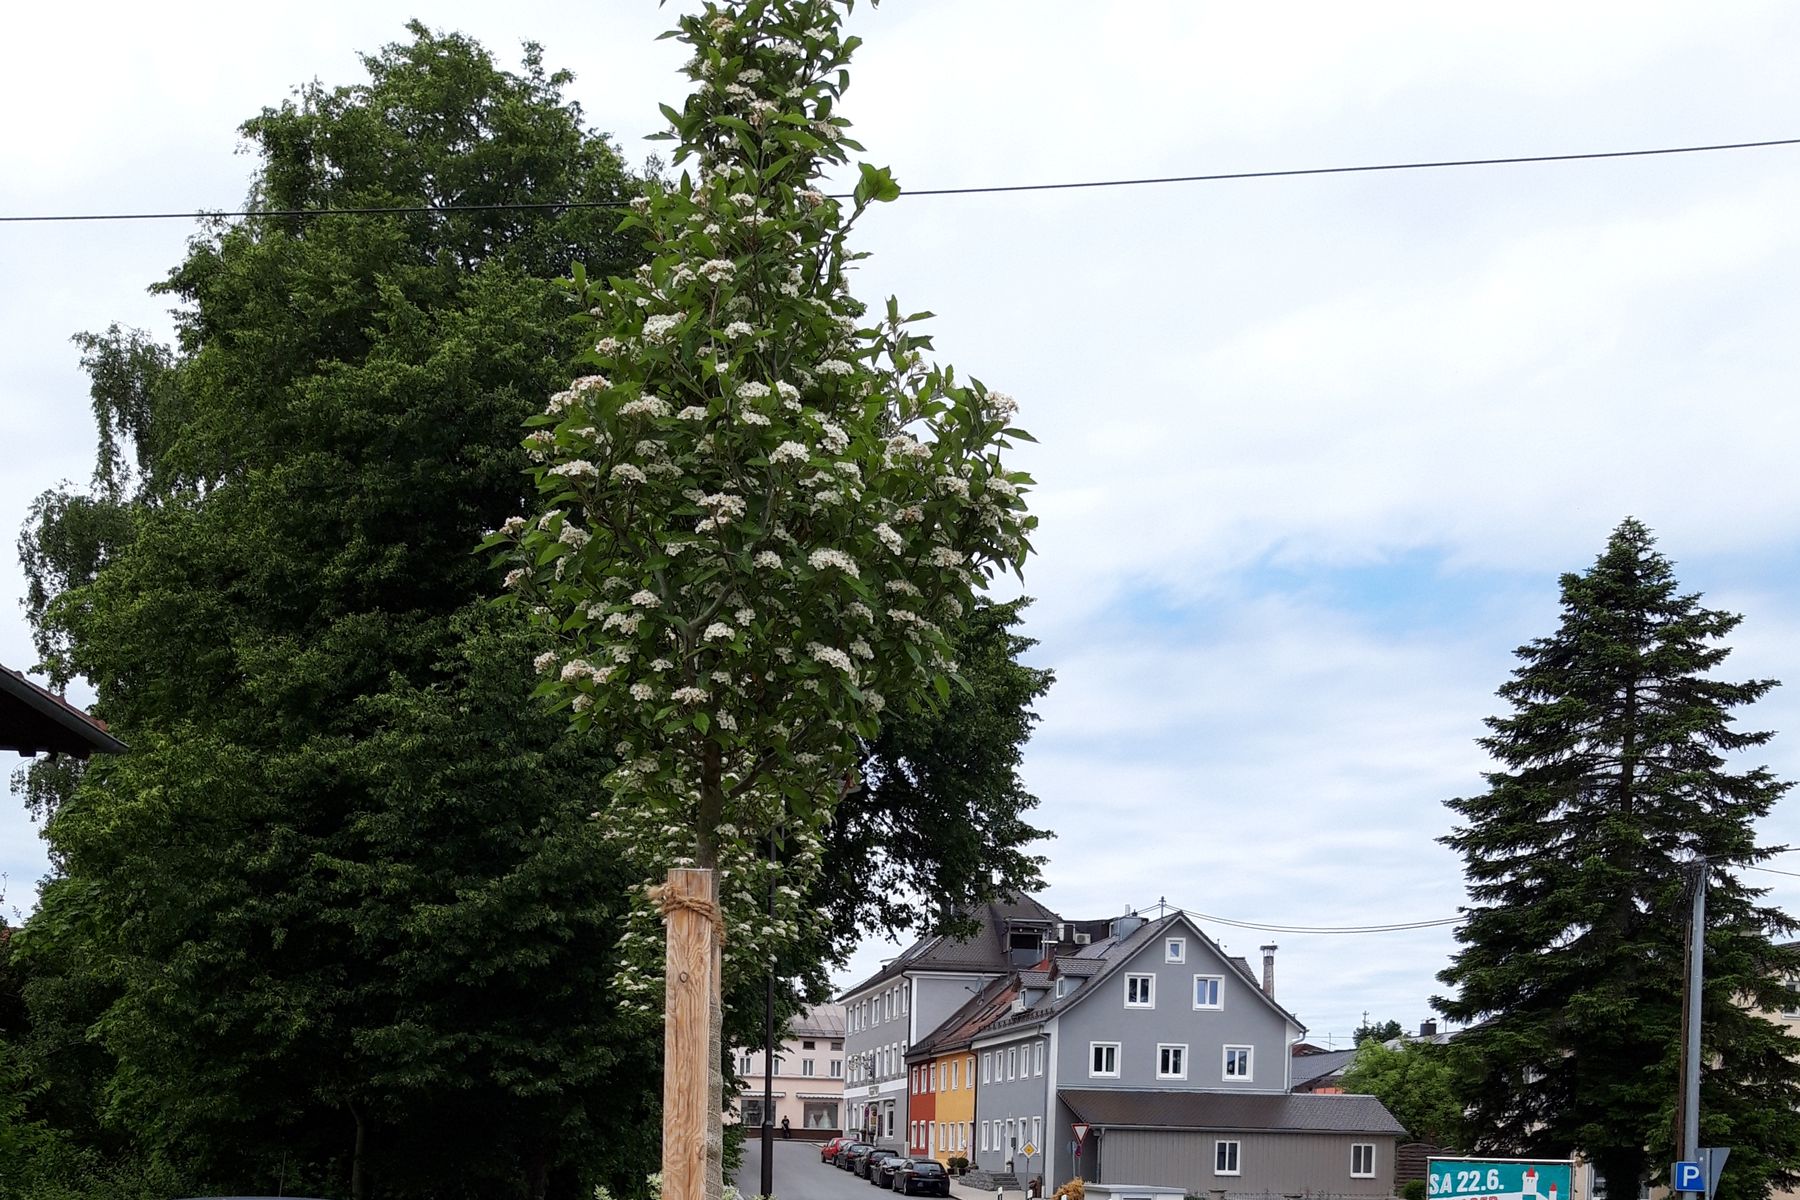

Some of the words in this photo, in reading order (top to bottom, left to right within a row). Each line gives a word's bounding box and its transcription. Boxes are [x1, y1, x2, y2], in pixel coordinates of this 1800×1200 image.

[1430, 1173, 1452, 1195] SA
[1456, 1169, 1505, 1193] 22.6.
[1683, 1166, 1699, 1187] P
